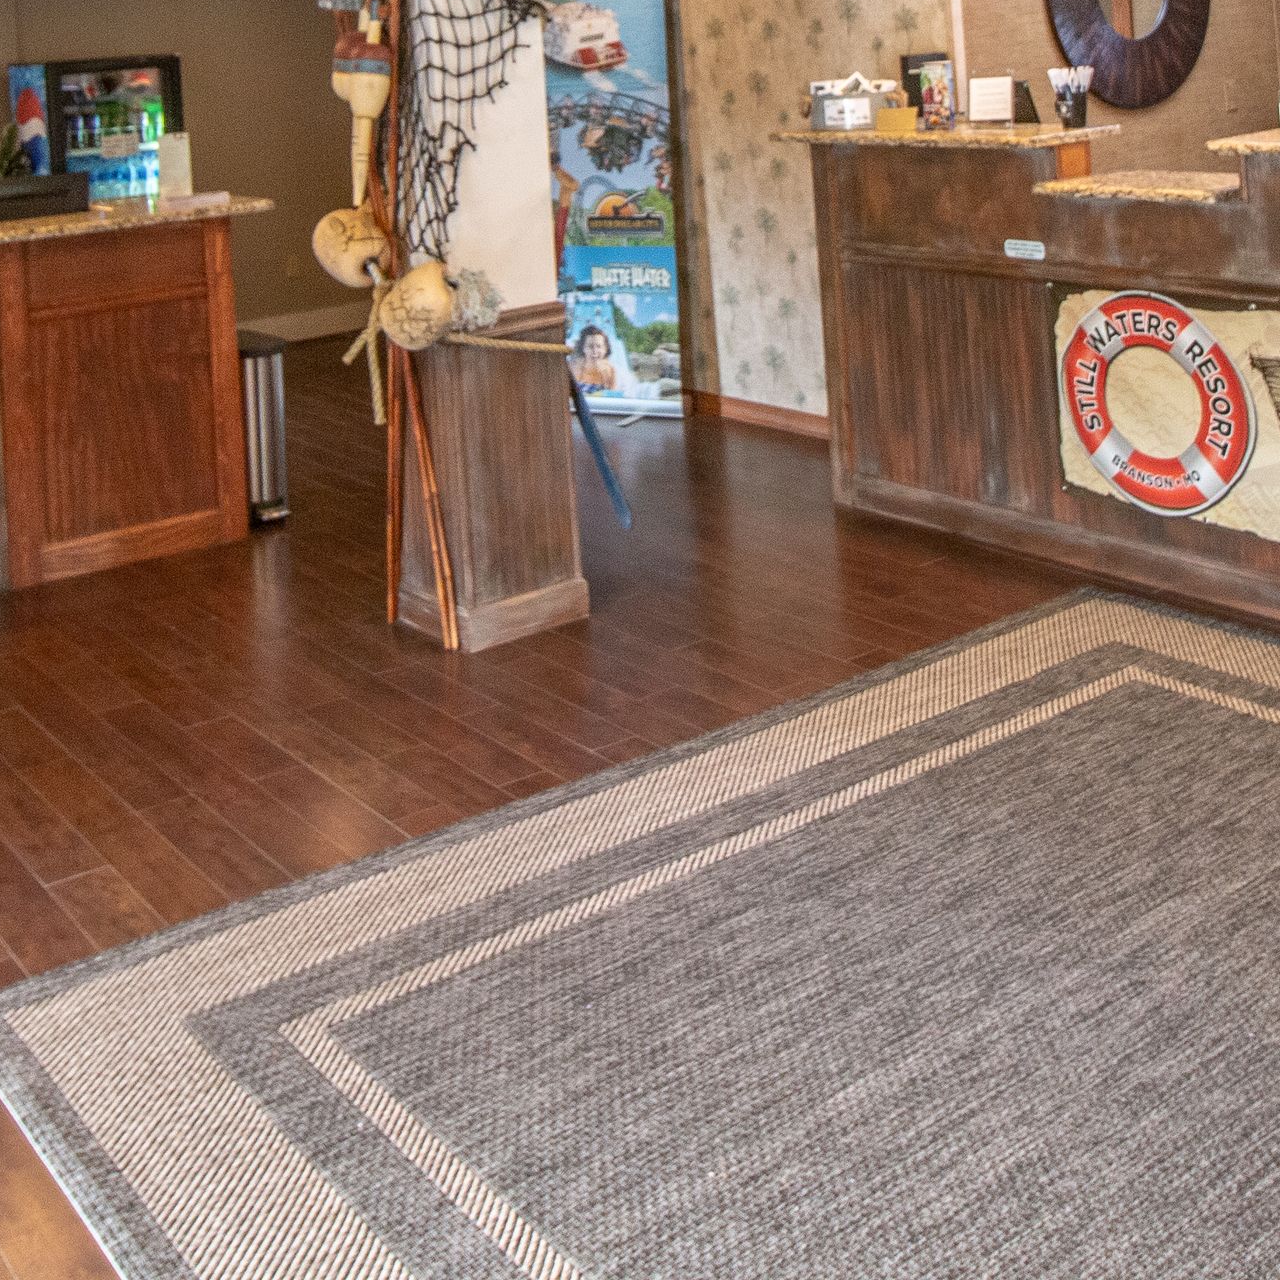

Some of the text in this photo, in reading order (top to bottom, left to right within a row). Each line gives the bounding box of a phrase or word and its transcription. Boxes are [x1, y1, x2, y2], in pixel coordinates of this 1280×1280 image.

[1076, 312, 1233, 458] STILL WATERS RESORT
[1112, 454, 1176, 489] BRANSON
